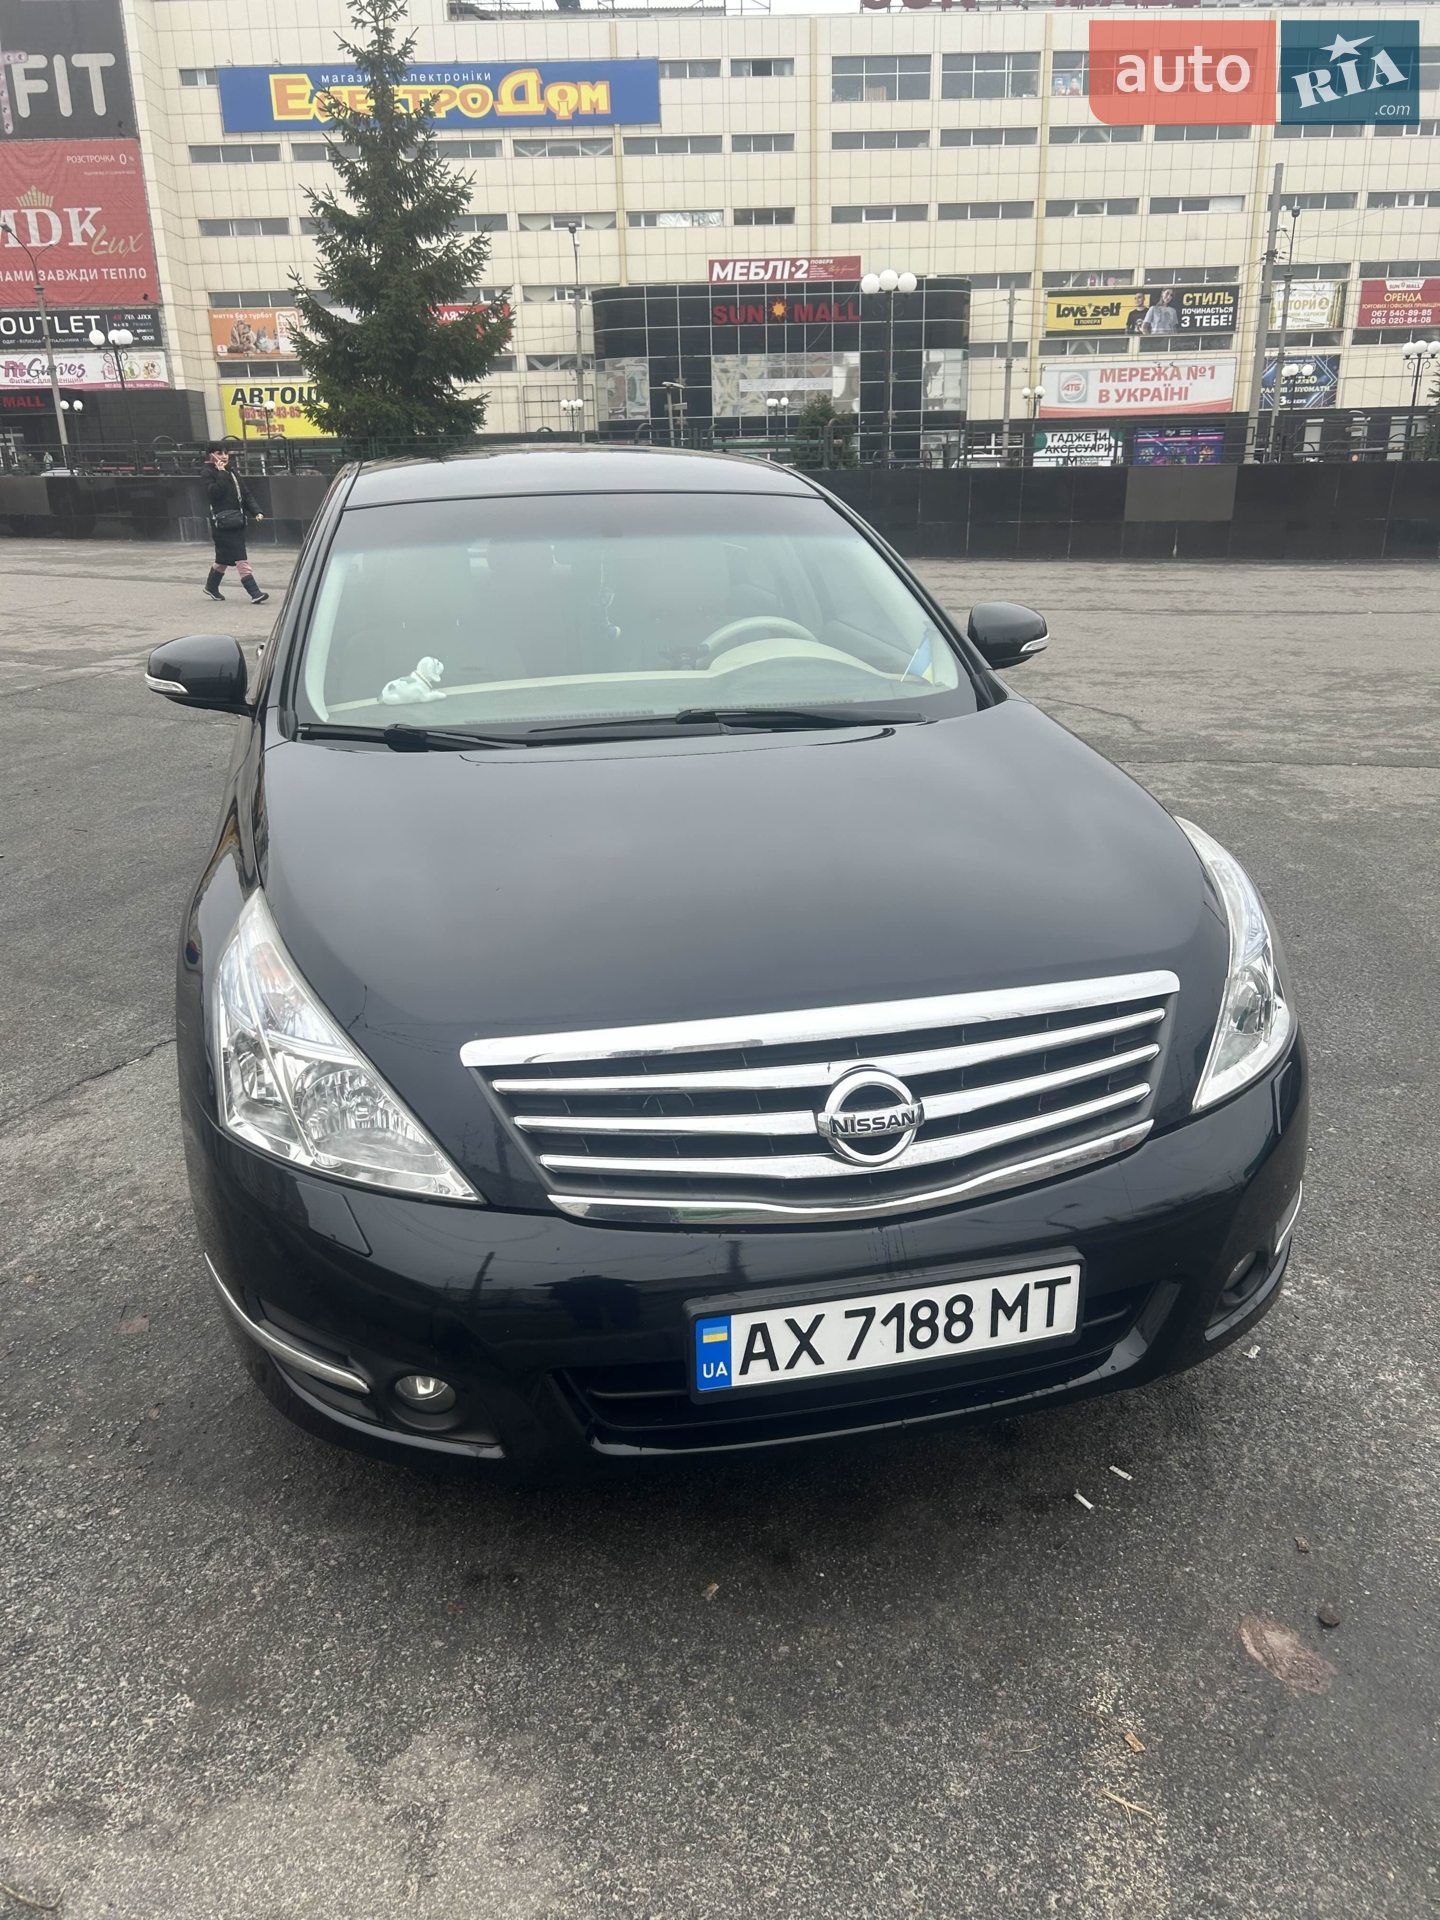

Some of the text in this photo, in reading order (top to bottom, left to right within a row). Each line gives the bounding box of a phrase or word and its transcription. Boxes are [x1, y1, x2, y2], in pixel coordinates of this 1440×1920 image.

[66, 154, 115, 164] РОЗСТРОЧКА
[119, 153, 127, 164] 0
[38, 268, 99, 282] ЗАВЖДИ
[101, 267, 147, 280] ТЕПЛО
[1182, 291, 1234, 306] СТИЛЬ
[1384, 292, 1422, 302] ОРЕНДА
[248, 312, 273, 320] турбот
[713, 302, 861, 324] SUN MALL
[1181, 306, 1234, 315] ПОЧИНАЄТЬСЯ
[0, 315, 101, 335] OUTLET
[1194, 315, 1233, 327] ТЕБЕ!
[1099, 365, 1216, 383] МЕРЕЖА №1
[1062, 383, 1082, 392] АТБ
[1098, 383, 1189, 403] В УКРАЇНІ
[3, 396, 46, 409] MALL
[1051, 432, 1107, 443] ГАДЖЕТИ
[1044, 443, 1112, 454] АКСЕСУАРИ
[830, 1110, 915, 1133] NISSAN
[738, 1276, 1072, 1376] AX 7188 MT
[702, 1361, 729, 1379] UA
